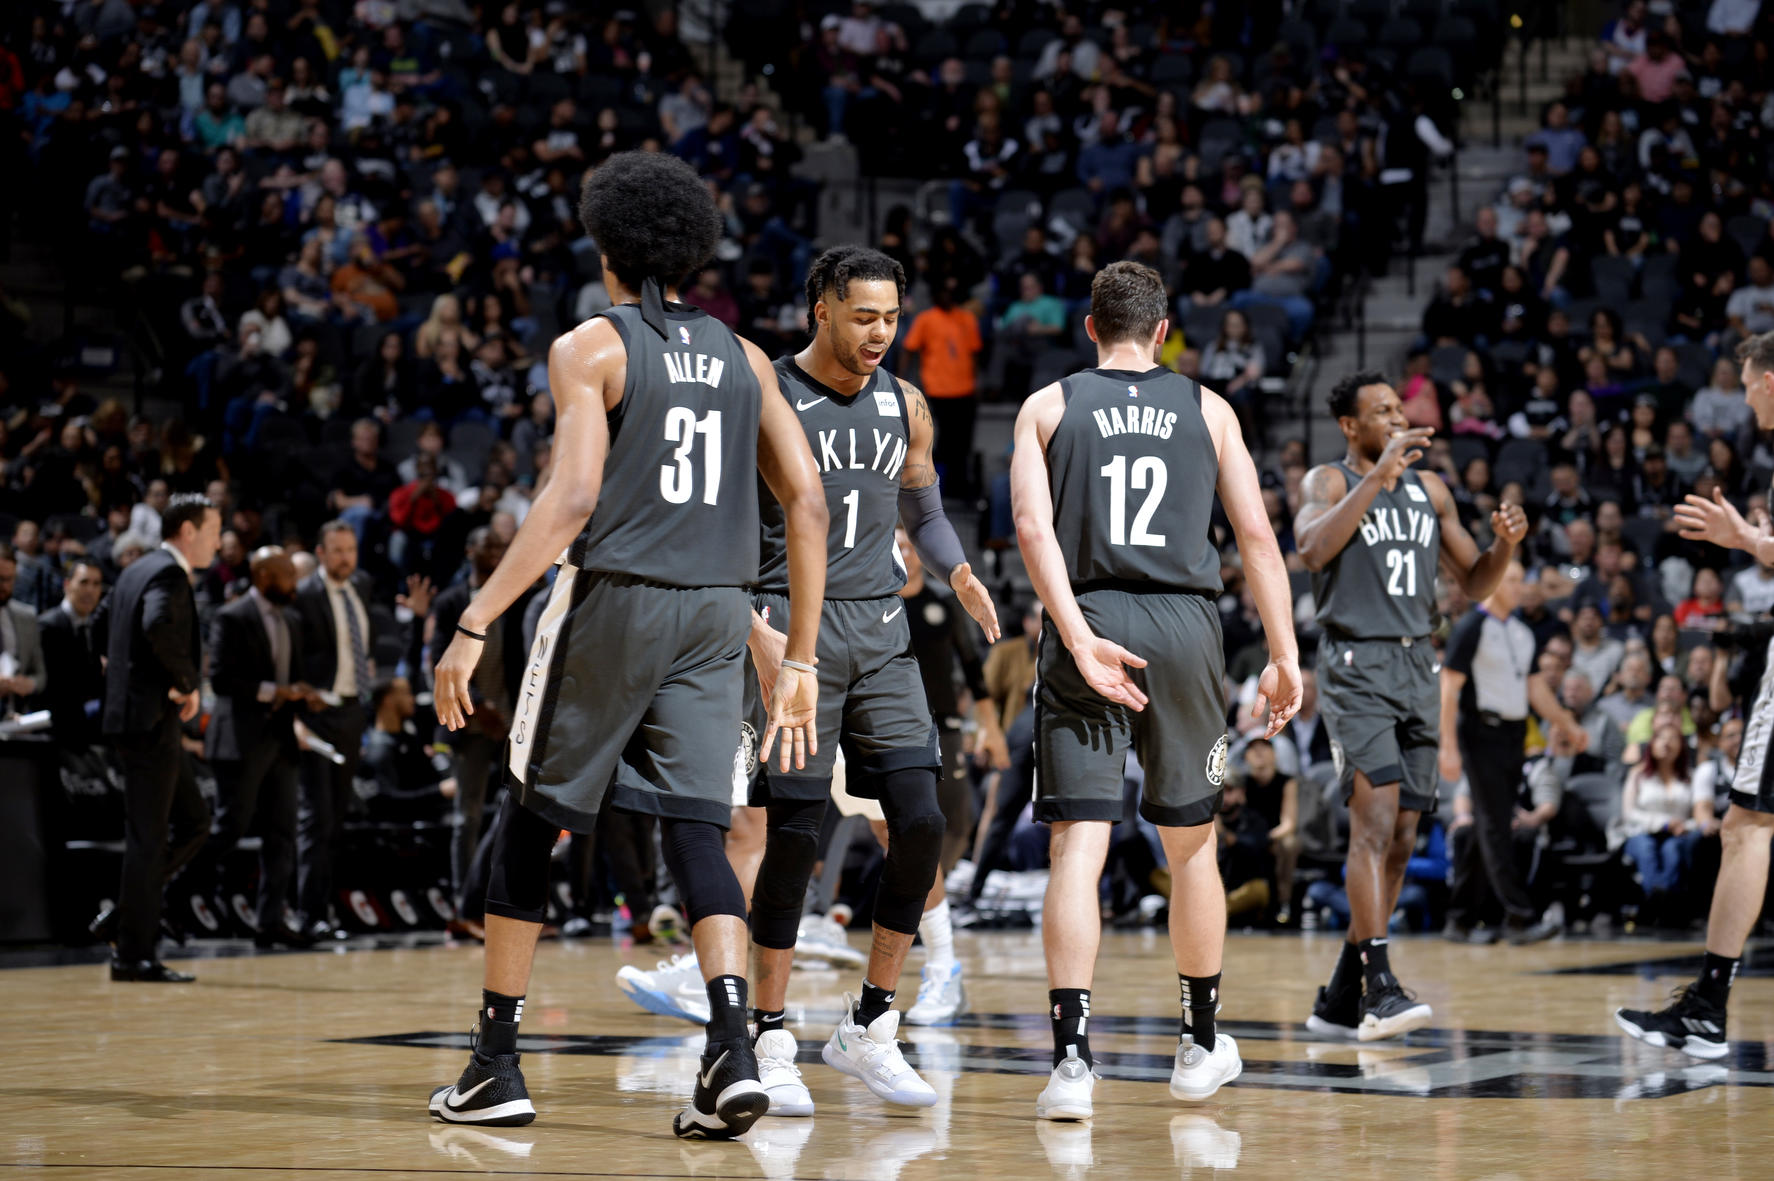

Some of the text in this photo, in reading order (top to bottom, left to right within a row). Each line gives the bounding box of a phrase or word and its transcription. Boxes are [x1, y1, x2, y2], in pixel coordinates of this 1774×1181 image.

[663, 352, 725, 389] ALLEN
[1092, 405, 1178, 440] HARRIS
[660, 406, 722, 506] 31
[813, 428, 907, 480] KLYN
[843, 489, 859, 548] 1
[1101, 455, 1168, 547] 12
[1386, 548, 1416, 597] 21
[515, 634, 548, 744] NETS
